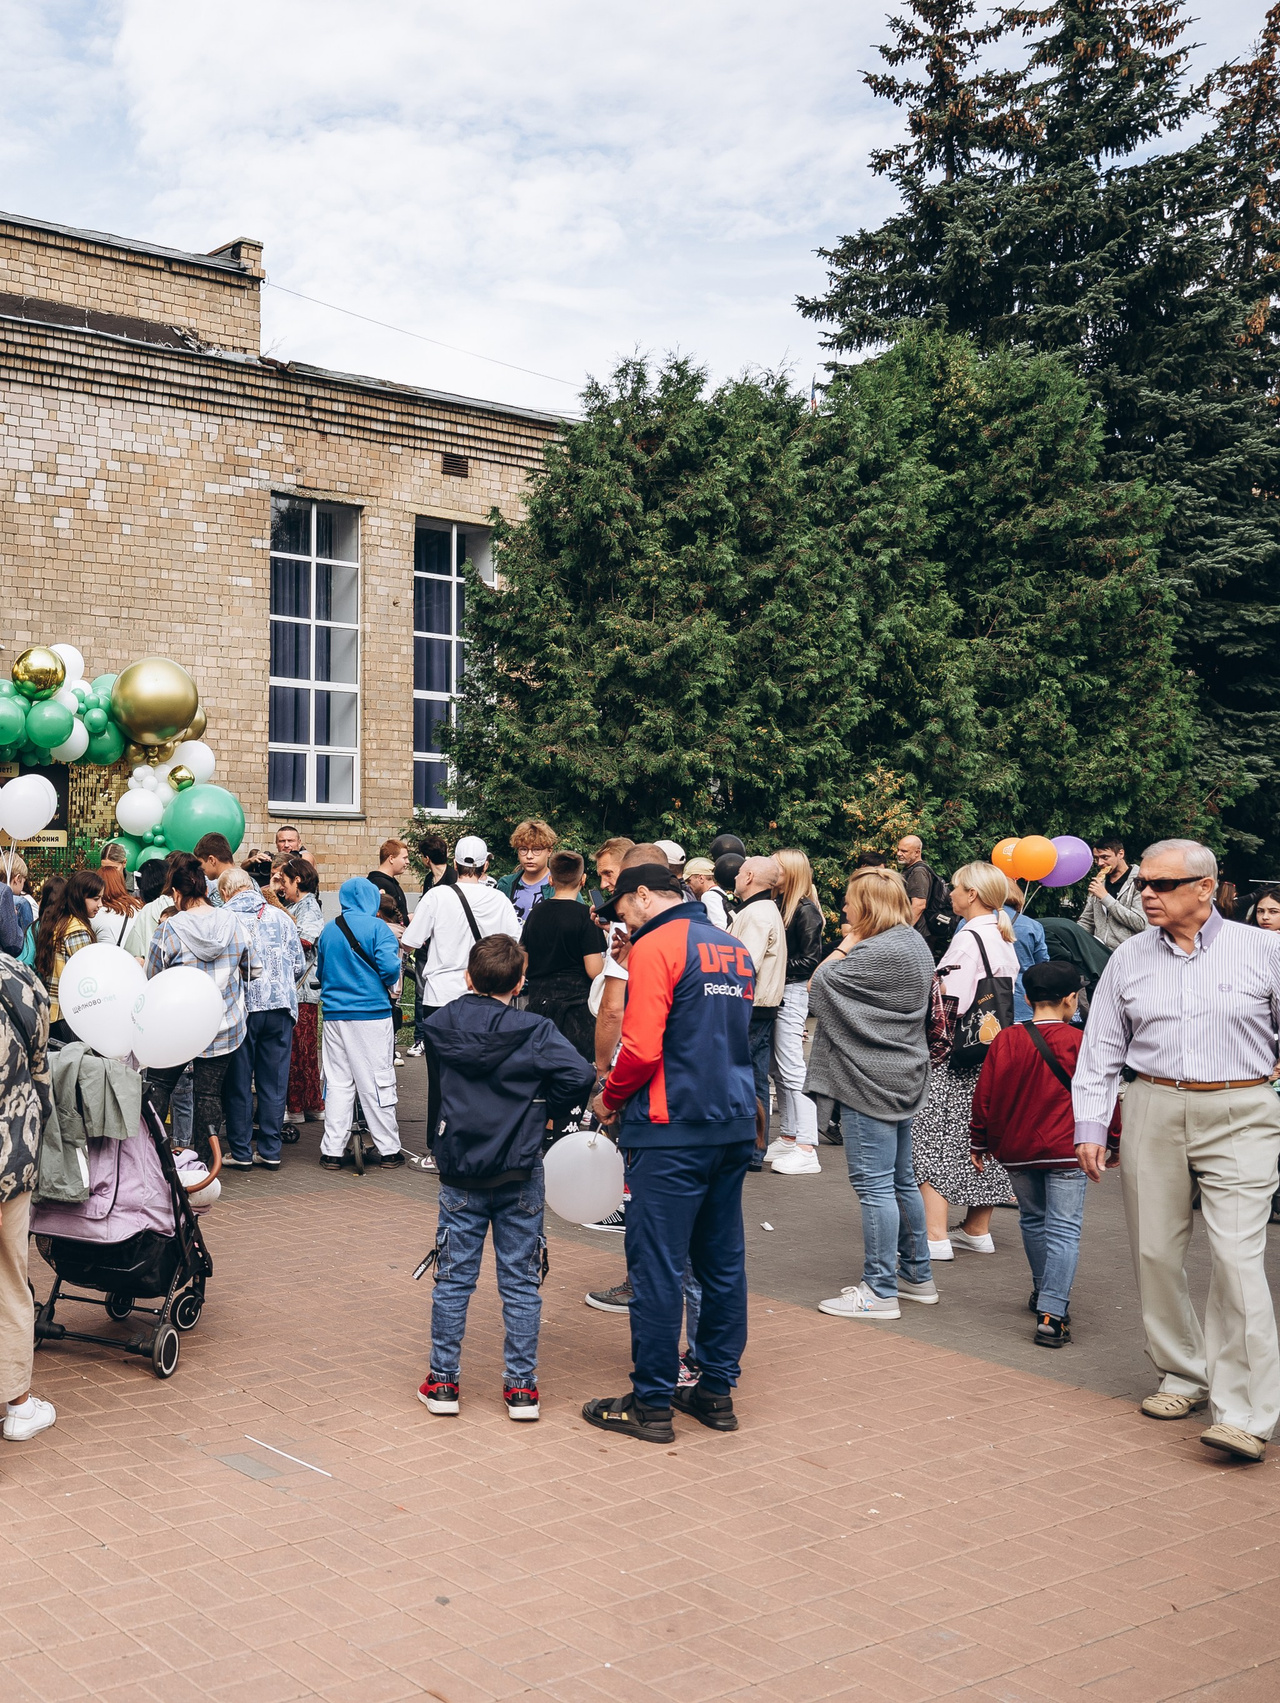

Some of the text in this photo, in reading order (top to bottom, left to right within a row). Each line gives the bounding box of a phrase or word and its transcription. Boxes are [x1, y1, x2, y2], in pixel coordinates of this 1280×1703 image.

[21, 834, 60, 844] лефония
[696, 942, 753, 977] UFC
[703, 982, 744, 998] Reebok
